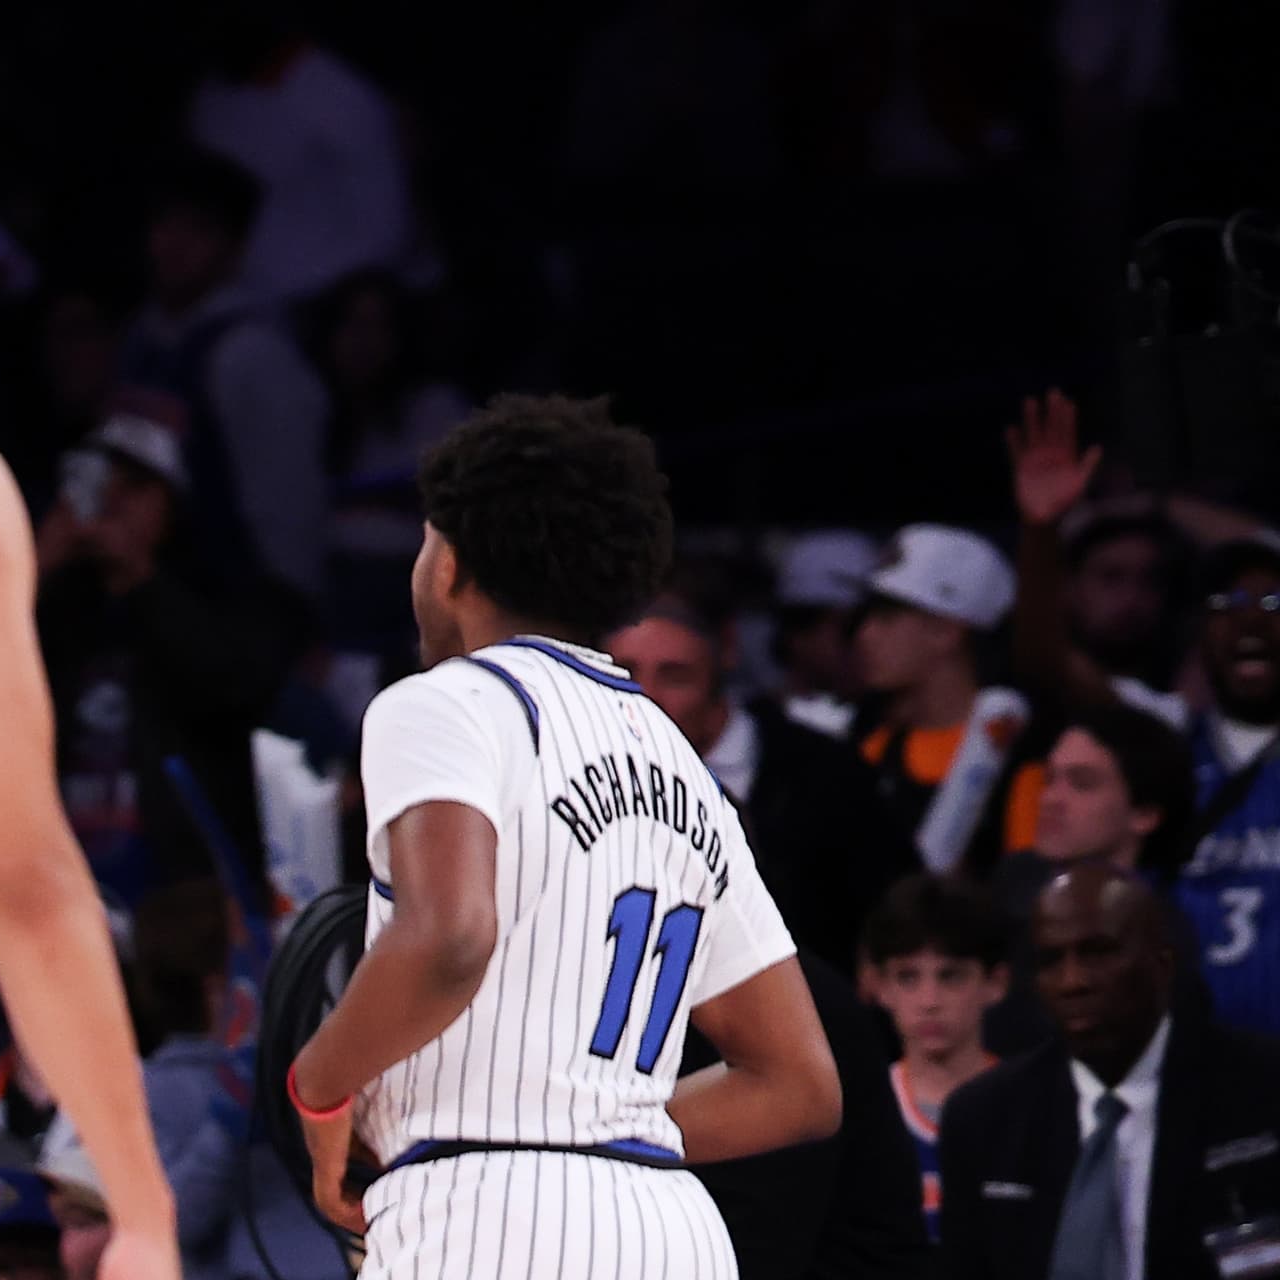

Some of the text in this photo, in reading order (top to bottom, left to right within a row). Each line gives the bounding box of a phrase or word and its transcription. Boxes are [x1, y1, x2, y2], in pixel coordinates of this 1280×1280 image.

[551, 753, 730, 902] RICHARDSON
[588, 884, 705, 1075] 11
[1206, 886, 1264, 967] 3
